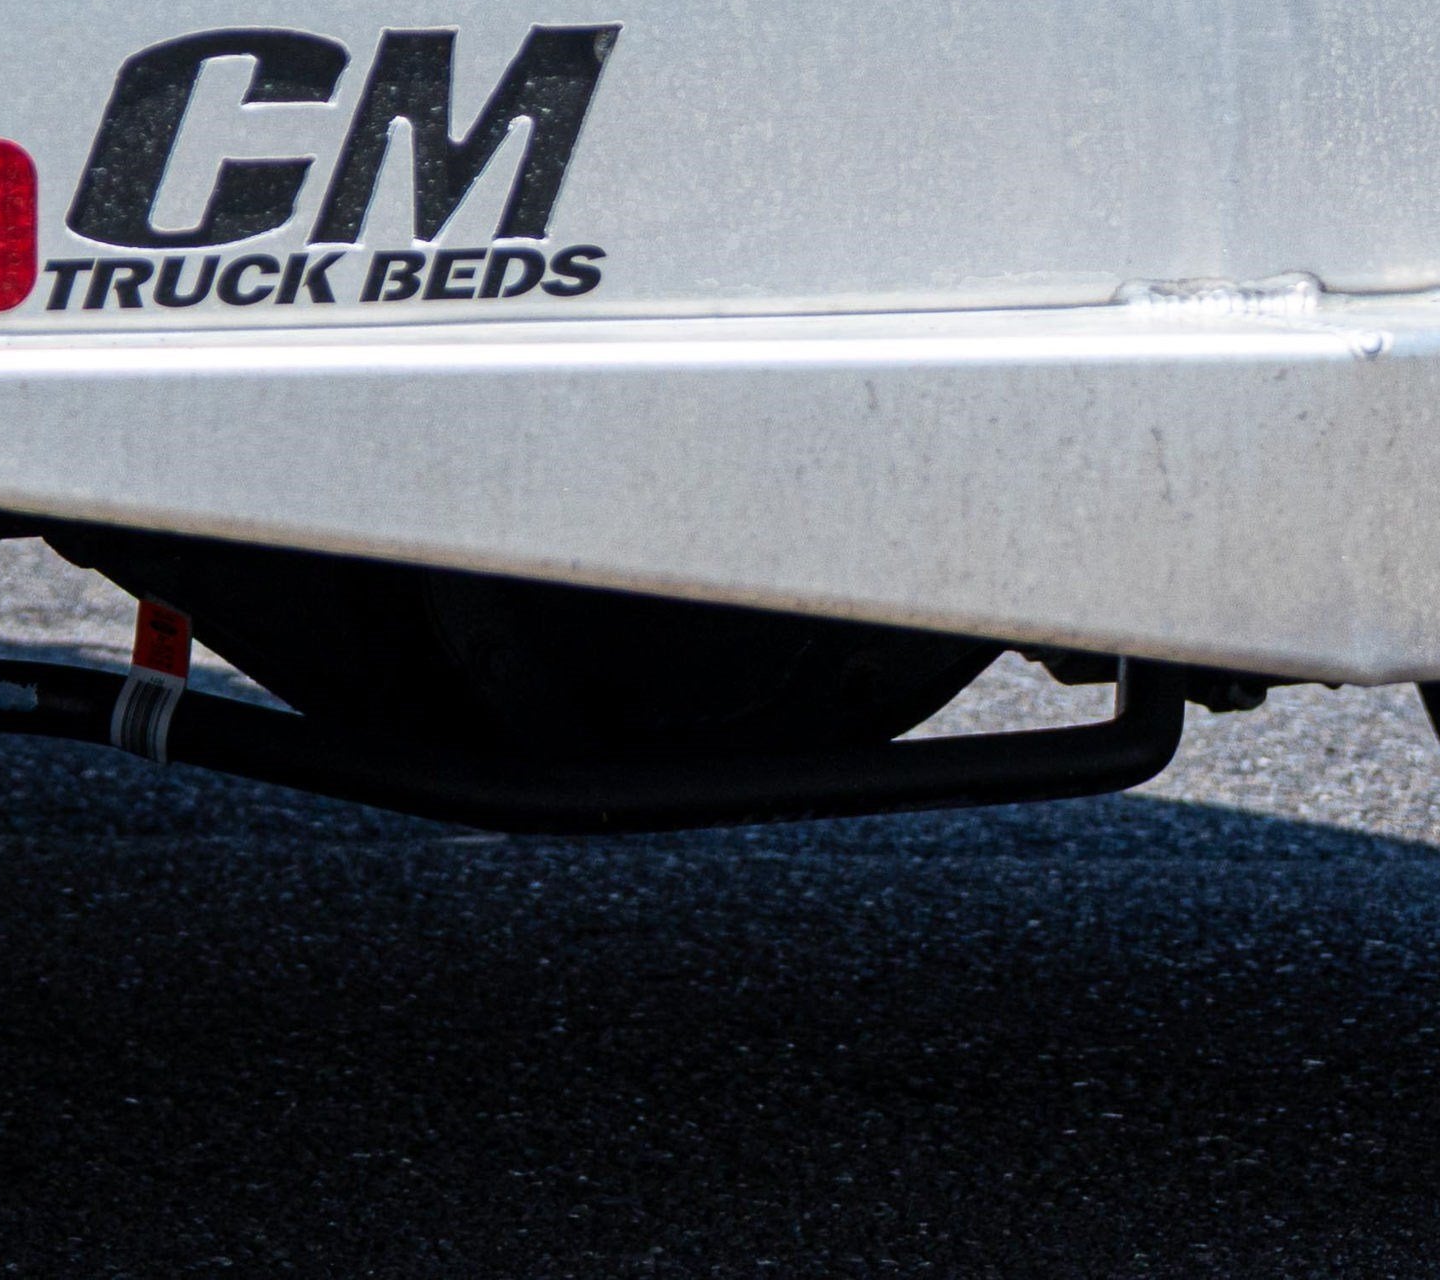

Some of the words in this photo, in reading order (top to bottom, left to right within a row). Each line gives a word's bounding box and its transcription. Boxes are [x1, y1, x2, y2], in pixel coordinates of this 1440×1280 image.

[64, 23, 624, 250] CM
[42, 248, 354, 312] TRUCK
[357, 243, 609, 305] BEDS
